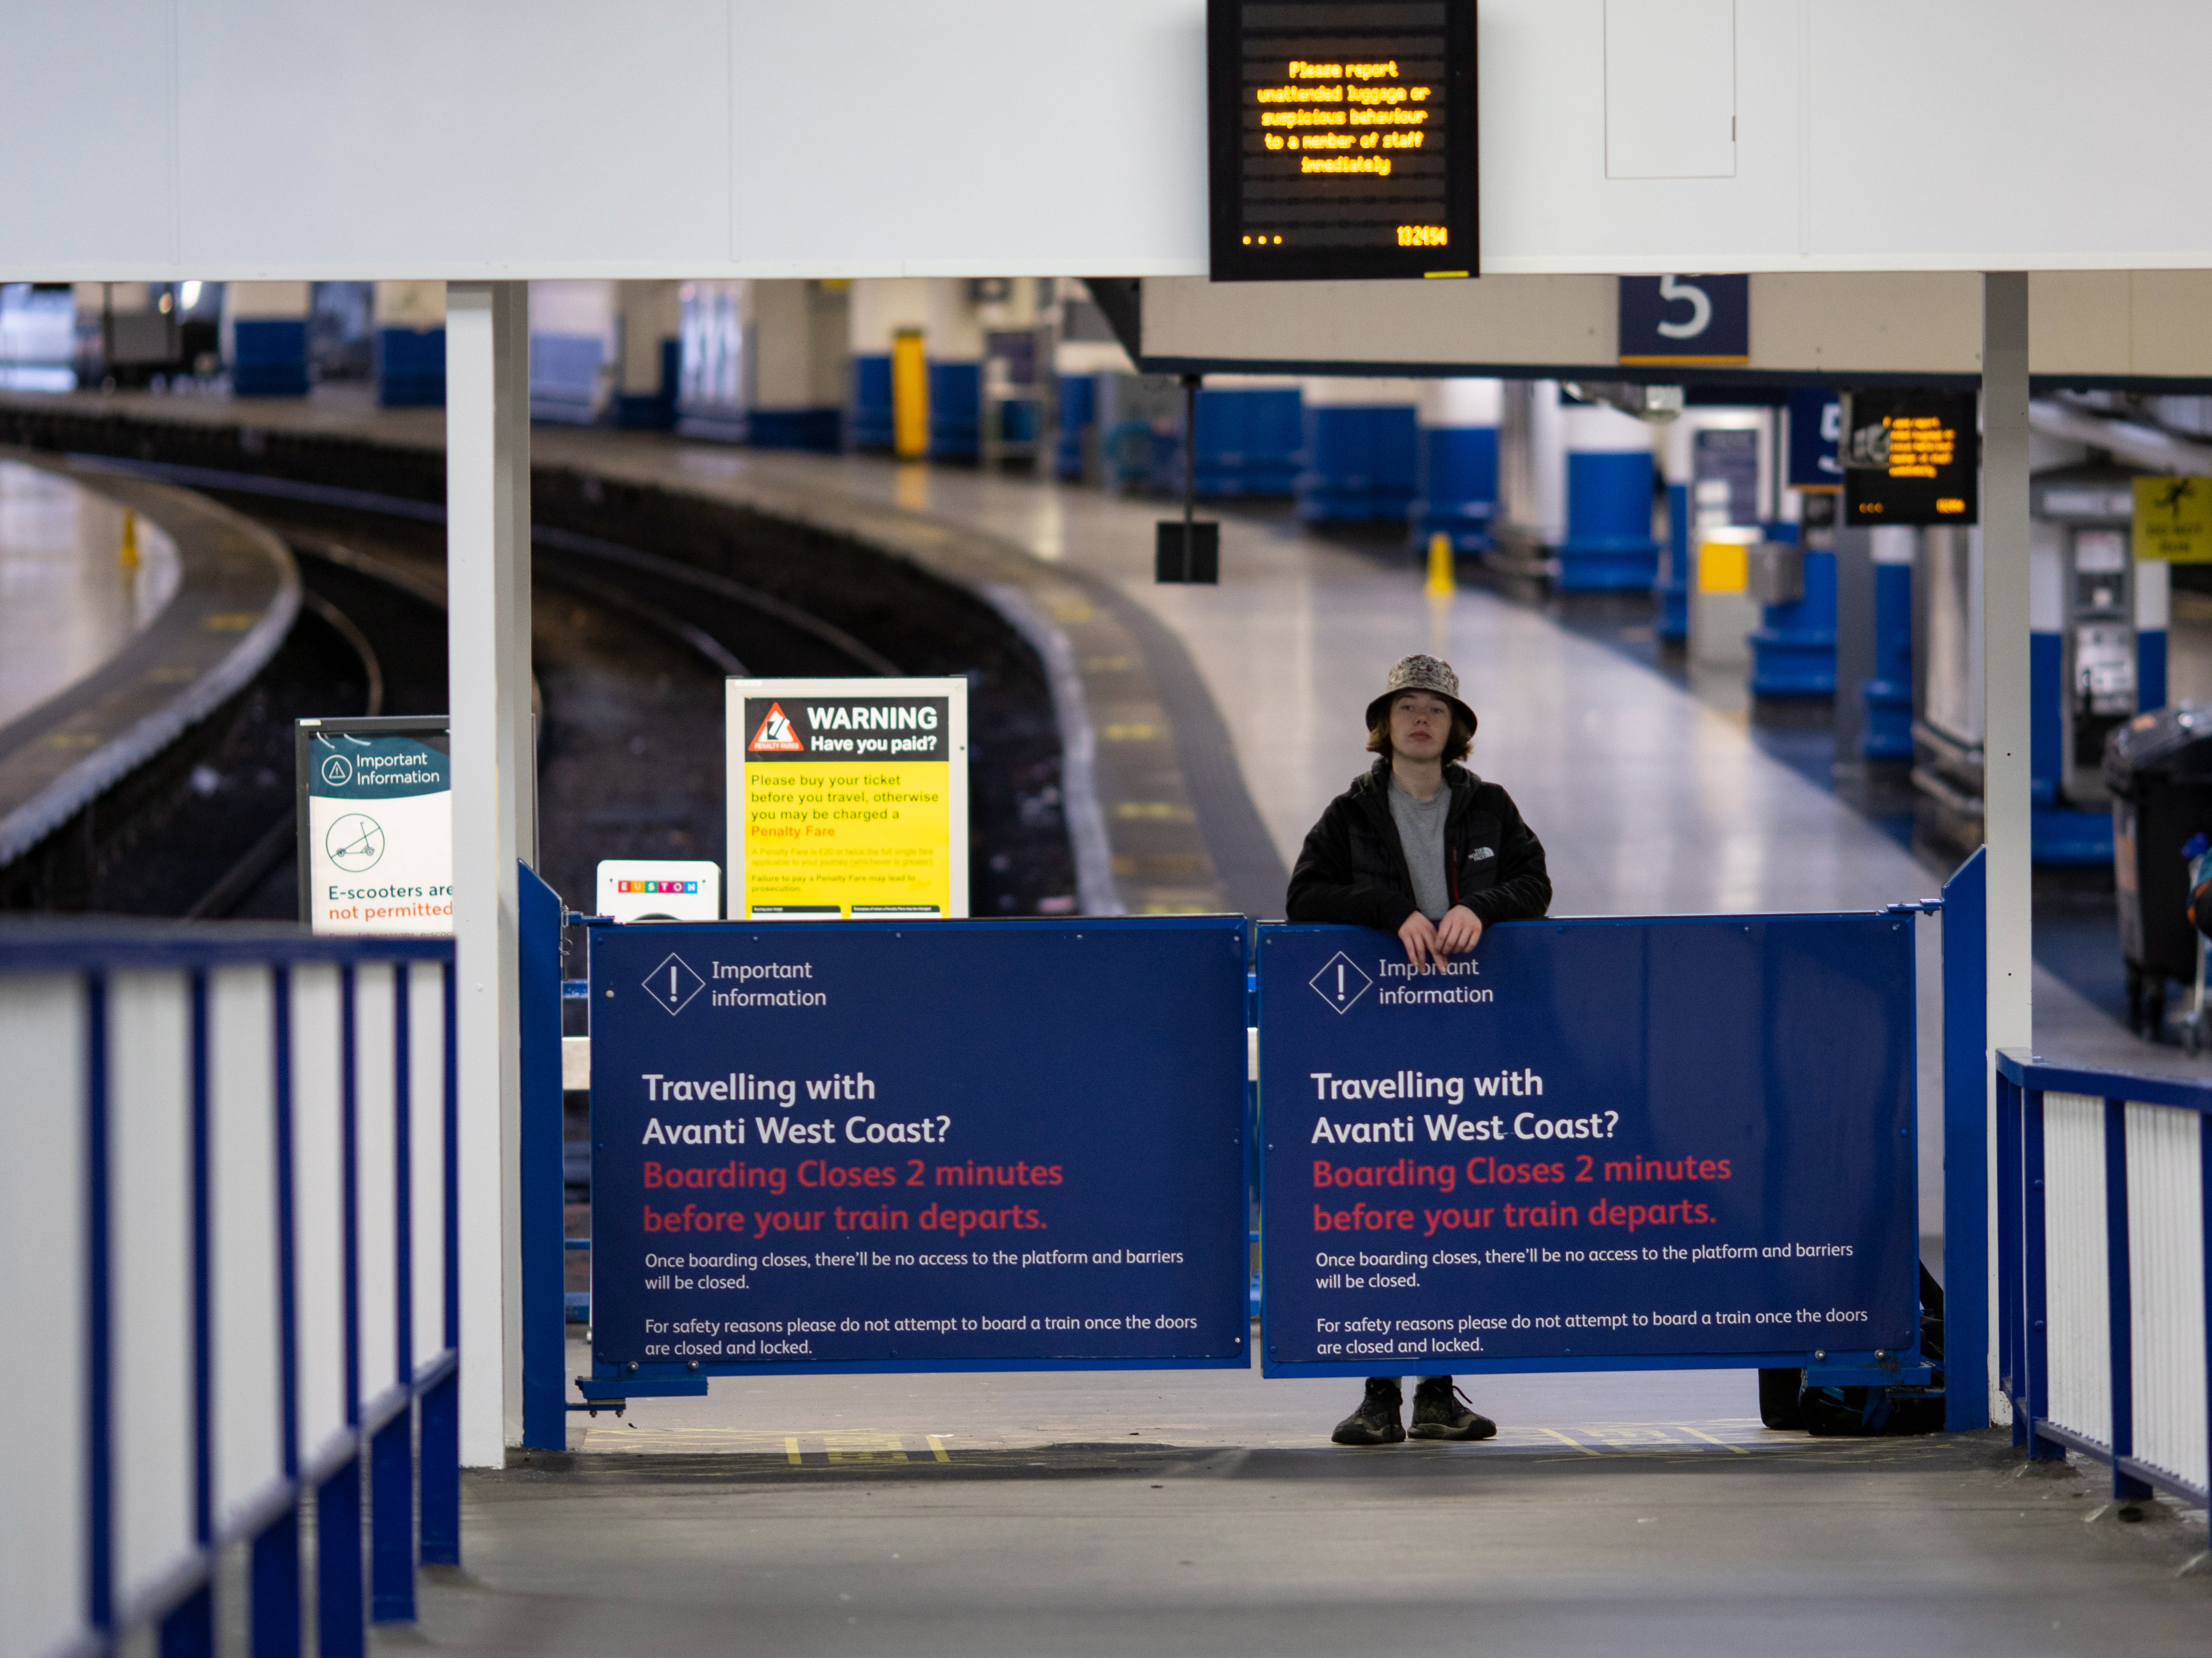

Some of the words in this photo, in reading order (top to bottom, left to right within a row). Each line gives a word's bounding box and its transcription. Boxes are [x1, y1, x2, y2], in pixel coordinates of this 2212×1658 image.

[1289, 62, 1343, 78] Please
[1345, 61, 1399, 81] report
[1257, 85, 1343, 102] unattended
[1347, 85, 1407, 104] luggage
[1410, 87, 1431, 100] or
[1261, 109, 1347, 129] suspicious
[1350, 108, 1428, 125] behaviour
[1265, 133, 1284, 149] to
[1287, 136, 1300, 149] a
[1302, 132, 1356, 149] member
[1360, 132, 1379, 148] of
[1382, 131, 1424, 148] staff
[1657, 275, 1713, 339] 5
[807, 706, 937, 730] WARNING
[811, 736, 854, 751] Have
[856, 739, 888, 754] you
[891, 735, 937, 754] paid?
[357, 752, 428, 770] Important
[357, 770, 440, 785] Information
[752, 775, 795, 785] Please
[800, 775, 824, 788] buy
[829, 777, 859, 788] your
[864, 775, 900, 785] ticket
[751, 792, 793, 803] before
[798, 795, 822, 805] you
[827, 792, 868, 803] travel,
[873, 792, 939, 802] otherwise
[751, 811, 775, 822] you
[781, 811, 808, 822] may
[813, 809, 829, 819] be
[833, 809, 887, 822] charged
[892, 811, 899, 819] a
[751, 826, 801, 839] Penalty
[806, 826, 835, 836] Fare
[620, 882, 696, 892] EUSTON
[816, 875, 846, 883] Penalty
[329, 885, 423, 900] E-scooters
[429, 886, 453, 896] are
[329, 906, 358, 919] not
[365, 901, 453, 922] permitted
[712, 961, 813, 983] Important
[1379, 957, 1479, 981] Imporant
[712, 988, 826, 1006] information
[1380, 986, 1493, 1004] information
[642, 1073, 795, 1107] Travelling
[806, 1072, 875, 1100] with
[1310, 1070, 1464, 1104] Travelling
[1474, 1068, 1543, 1096] with
[642, 1118, 745, 1145] Avanti
[755, 1117, 836, 1144] West
[845, 1115, 951, 1143] Coast?
[1311, 1115, 1413, 1144] Avanti
[1424, 1114, 1504, 1141] West
[1514, 1110, 1619, 1140] Coast?
[644, 1160, 787, 1195] Boarding
[797, 1160, 896, 1187] Closes
[906, 1159, 924, 1187] 2
[936, 1160, 1063, 1186] minutes
[1313, 1158, 1456, 1193] Boarding
[1466, 1156, 1565, 1185] Closes
[1575, 1155, 1593, 1182] 2
[1604, 1154, 1732, 1181] minutes
[644, 1204, 745, 1232] before
[754, 1211, 825, 1240] your
[834, 1204, 908, 1231] train
[919, 1202, 1047, 1237] departs.
[1314, 1202, 1414, 1231] before
[1424, 1208, 1495, 1237] your
[1503, 1200, 1578, 1228] train
[1588, 1197, 1716, 1233] departs.
[645, 1253, 685, 1268] Once
[689, 1253, 757, 1271] boarding
[762, 1252, 811, 1268] closes,
[872, 1251, 891, 1266] be
[895, 1255, 915, 1266] no
[919, 1254, 968, 1265] access
[972, 1252, 988, 1265] to
[992, 1250, 1018, 1265] the
[1022, 1249, 1088, 1268] platform
[1092, 1249, 1122, 1264] and
[1126, 1249, 1184, 1264] barriers
[1316, 1252, 1355, 1267] Once
[1359, 1251, 1428, 1269] boarding
[1432, 1250, 1481, 1266] closes,
[1542, 1248, 1561, 1262] be
[1565, 1251, 1585, 1262] no
[1589, 1250, 1638, 1261] access
[1642, 1247, 1658, 1260] to
[1662, 1245, 1688, 1260] the
[1692, 1243, 1757, 1263] platform
[1762, 1243, 1791, 1258] and
[1796, 1242, 1853, 1257] barriers
[645, 1275, 670, 1289] will
[675, 1275, 694, 1289] be
[698, 1274, 749, 1289] closed.
[1316, 1274, 1341, 1289] will
[1346, 1274, 1365, 1288] be
[1368, 1272, 1420, 1288] closed.
[646, 1319, 669, 1333] For
[673, 1318, 720, 1336] safety
[725, 1322, 783, 1332] reasons
[787, 1318, 836, 1336] please
[840, 1317, 860, 1332] do
[864, 1318, 890, 1331] not
[894, 1318, 957, 1334] attempt
[961, 1318, 978, 1330] to
[982, 1316, 1026, 1330] board
[1030, 1319, 1041, 1330] a
[1045, 1316, 1080, 1330] train
[1084, 1318, 1122, 1329] once
[1125, 1314, 1151, 1329] the
[1155, 1314, 1197, 1329] doors
[1317, 1318, 1341, 1332] For
[1344, 1317, 1392, 1335] safety
[1396, 1319, 1454, 1331] reasons
[1458, 1315, 1507, 1333] please
[1511, 1314, 1531, 1328] do
[1535, 1315, 1561, 1328] not
[1565, 1314, 1628, 1330] attempt
[1632, 1313, 1648, 1326] to
[1653, 1310, 1697, 1326] board
[1701, 1314, 1711, 1325] a
[1715, 1311, 1751, 1324] train
[1755, 1312, 1792, 1324] once
[1796, 1309, 1822, 1323] the
[1826, 1308, 1868, 1322] doors
[645, 1345, 670, 1355] are
[674, 1340, 722, 1355] closed
[726, 1340, 756, 1355] and
[760, 1339, 812, 1354] locked.
[1317, 1343, 1342, 1355] are
[1346, 1338, 1393, 1354] closed
[1398, 1338, 1427, 1353] and
[1432, 1336, 1483, 1352] locked.
